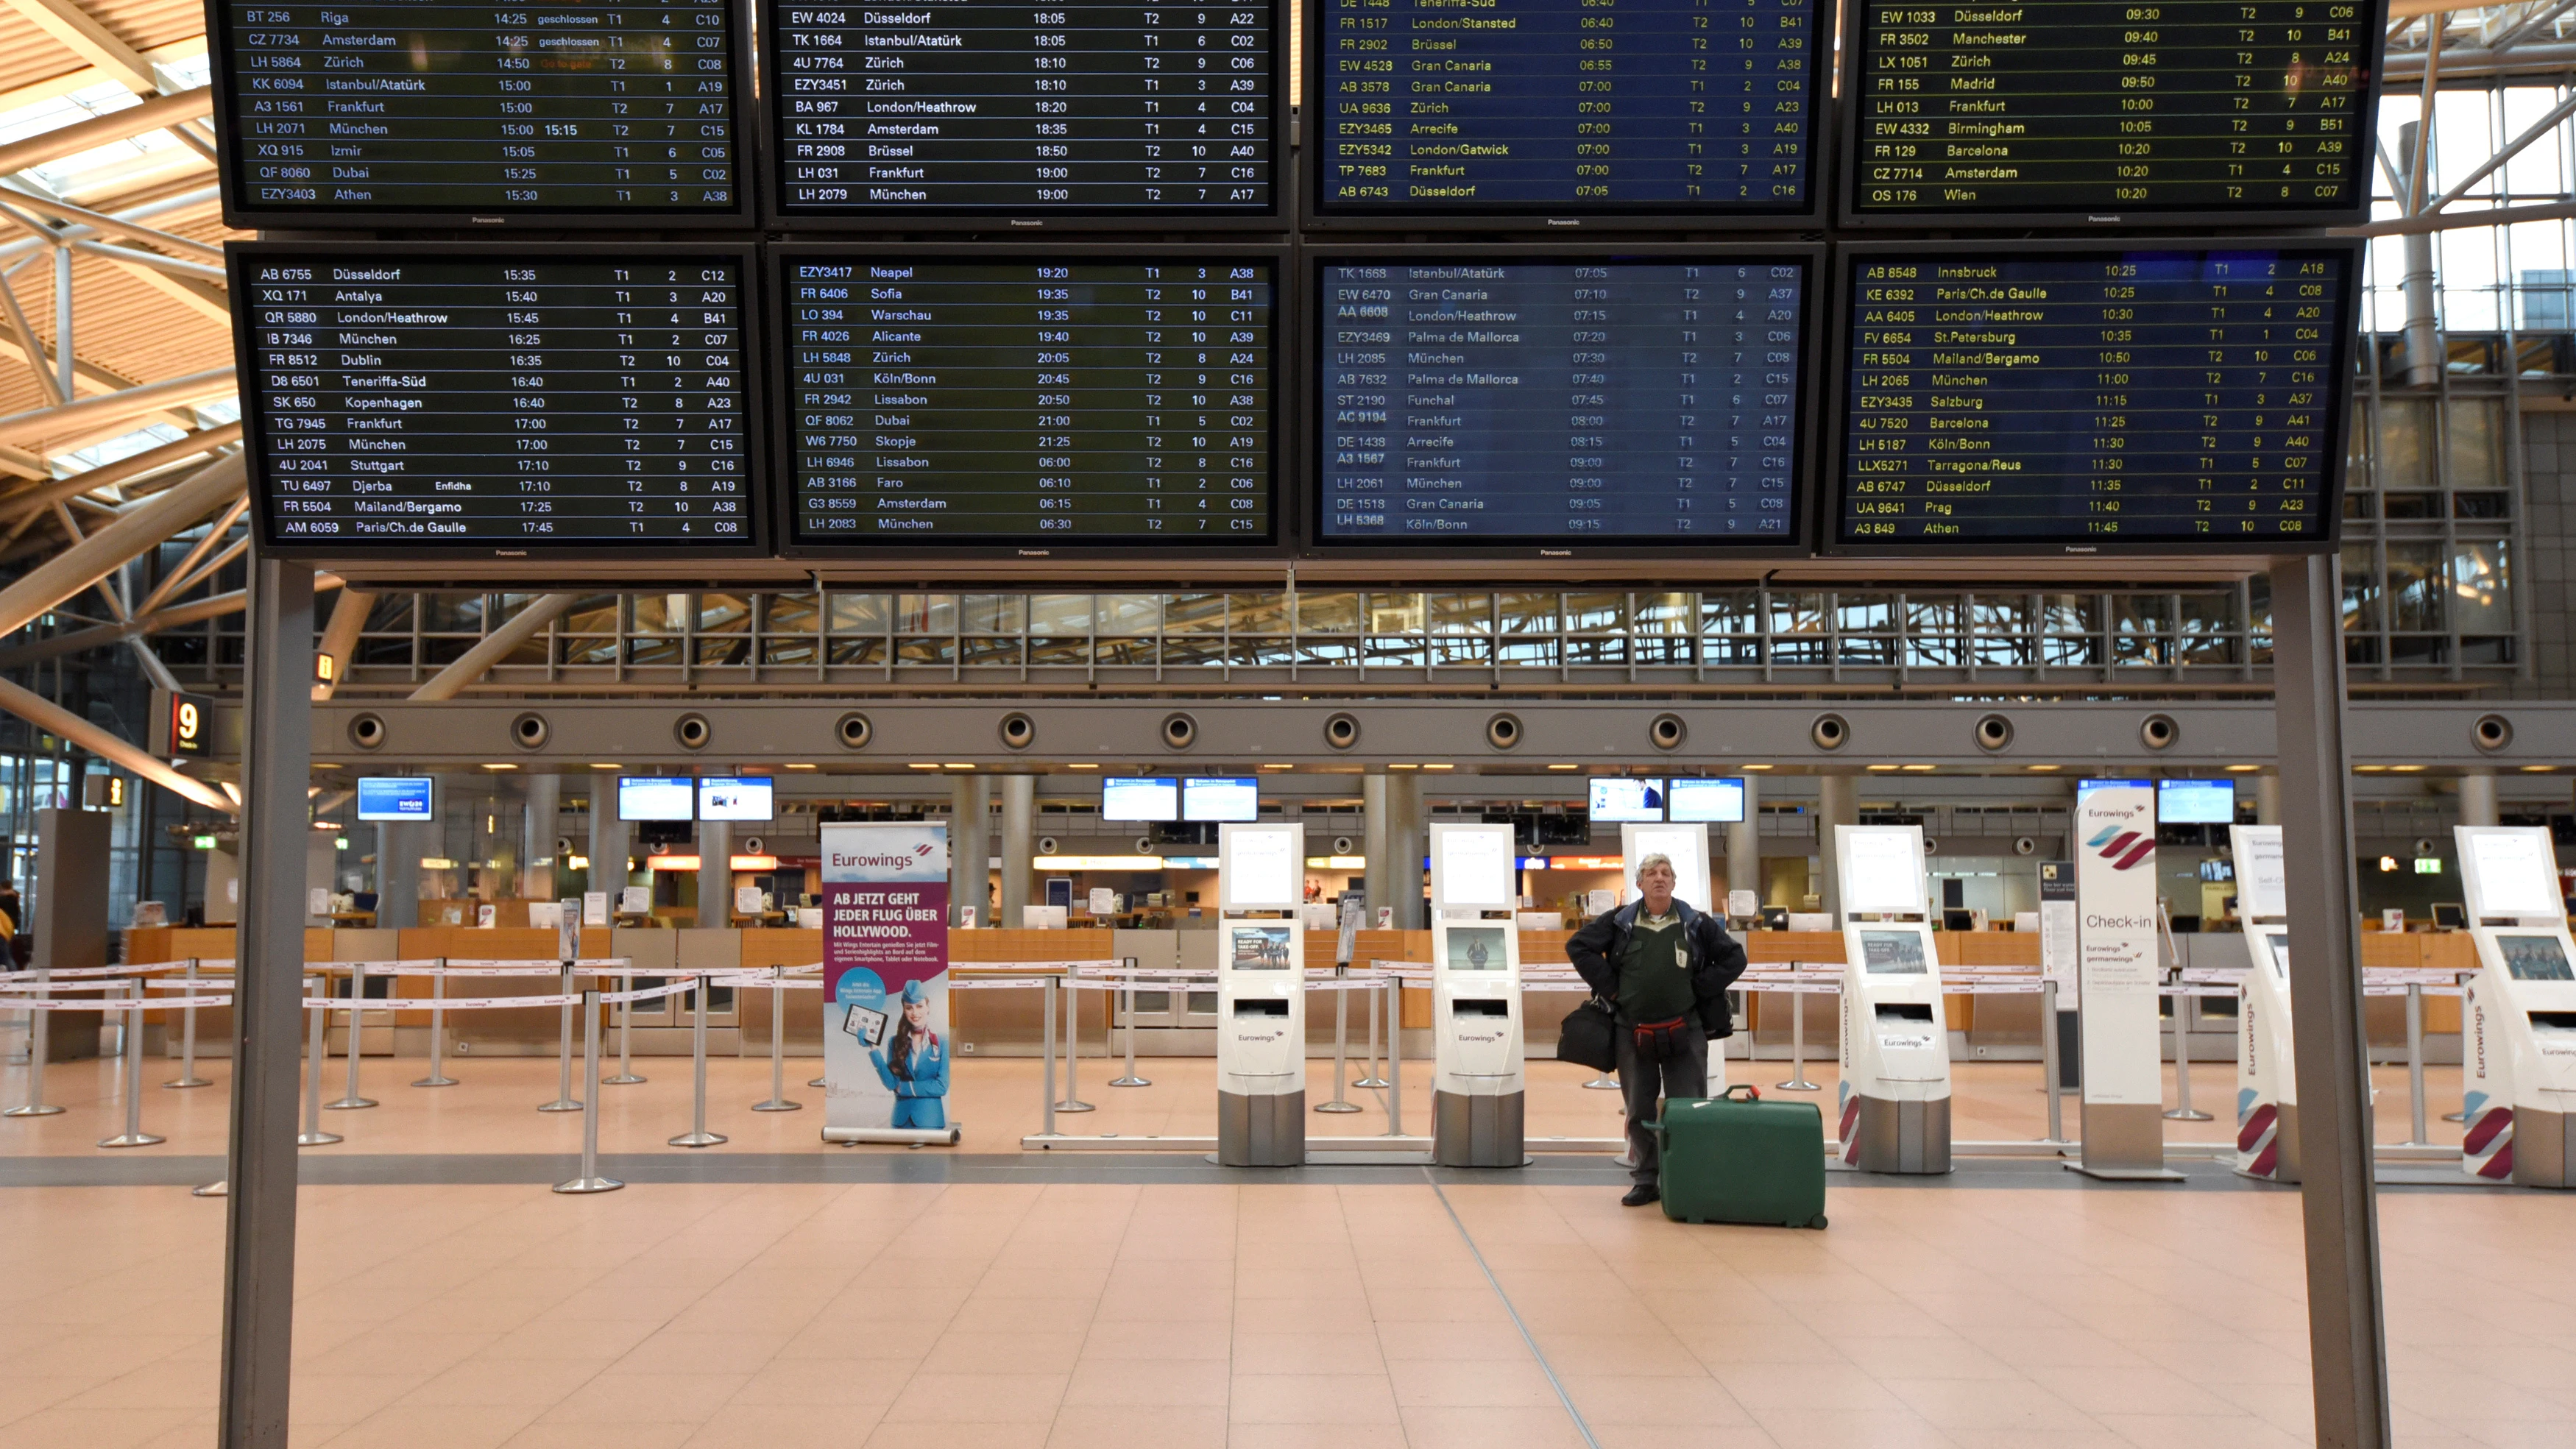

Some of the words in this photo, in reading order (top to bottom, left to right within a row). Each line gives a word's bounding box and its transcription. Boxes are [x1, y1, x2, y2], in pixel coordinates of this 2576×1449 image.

[793, 35, 809, 45] TK
[814, 35, 842, 45] 1664
[866, 35, 961, 46] Istanbul/Atatürk
[1035, 35, 1065, 46] 18:05
[1144, 35, 1158, 46] T1
[1198, 36, 1205, 46] 6
[1231, 35, 1253, 46] C02
[1881, 34, 1895, 45] FR
[1900, 34, 1928, 45] 3502
[1954, 32, 2026, 44] Manchester
[2125, 32, 2158, 42] 09:40
[2239, 30, 2254, 41] T2
[2287, 29, 2301, 40] 10
[2328, 29, 2349, 40] B41
[1340, 60, 1360, 71] EW
[1364, 61, 1393, 71] 4528
[1412, 60, 1440, 71] Gran
[1446, 60, 1490, 71] Canaria
[1580, 60, 1611, 70] 06:55
[1691, 60, 1705, 70] T2
[1746, 60, 1752, 69] 9
[1777, 60, 1800, 69] A38
[255, 101, 271, 111] A3
[276, 102, 302, 112] 1561
[328, 101, 384, 112] Frankfurt
[500, 103, 532, 113] 15:00
[612, 103, 627, 113] T2
[667, 104, 673, 113] 7
[699, 104, 722, 113] A17
[796, 101, 813, 112] BA
[817, 102, 838, 112] 967
[868, 102, 976, 112] London/Heathrow
[1036, 102, 1066, 112] 18:20
[1145, 102, 1158, 112] T1
[1198, 102, 1206, 112] 4
[1231, 102, 1254, 113] C04
[257, 123, 272, 133] LH
[277, 123, 304, 133] 2071
[330, 124, 387, 134] München
[502, 124, 533, 135] 15:00
[545, 125, 577, 135] 15:15
[613, 125, 628, 135] T2
[668, 126, 674, 135] 7
[701, 125, 724, 135] C15
[1876, 124, 1897, 134] EW
[1900, 124, 1929, 134] 4332
[1949, 122, 2024, 136] Birmingham
[2120, 121, 2151, 132] 10:05
[2232, 120, 2247, 131] T2
[2287, 120, 2294, 130] 9
[2321, 118, 2342, 130] B51
[266, 312, 283, 322] QR
[288, 313, 316, 322] 5880
[338, 312, 447, 323] London/Heathrow
[508, 313, 538, 323] 15:45
[618, 313, 631, 323] T1
[671, 313, 679, 323] 4
[704, 313, 725, 323] B41
[1865, 311, 1883, 322] AA
[1887, 311, 1914, 322] 6405
[1936, 310, 2043, 321] London/Heathrow
[2103, 309, 2133, 319] 10:30
[2212, 308, 2224, 318] T1
[2265, 308, 2271, 317] 4
[2296, 307, 2319, 317] A20
[803, 330, 817, 341] FR
[821, 331, 849, 341] 4026
[873, 331, 921, 341] Alicante
[1038, 332, 1069, 341] 19:40
[1146, 332, 1160, 341] T2
[1192, 332, 1206, 341] 10
[1230, 332, 1253, 341] A39
[1338, 353, 1354, 363] LH
[1358, 353, 1385, 363] 2085
[1409, 353, 1463, 363] München
[1574, 353, 1605, 363] 07:30
[1682, 352, 1696, 363] T2
[1735, 352, 1741, 362] 7
[1767, 352, 1789, 362] C08
[274, 397, 291, 407] SK
[294, 397, 315, 407] 650
[346, 397, 422, 410] Kopenhagen
[514, 398, 544, 408] 16:40
[622, 397, 637, 408] T2
[676, 398, 683, 408] 8
[707, 398, 731, 408] A23
[806, 436, 826, 445] W6
[829, 436, 857, 446] 7750
[876, 436, 916, 448] Skopje
[1039, 436, 1069, 446] 21:25
[1147, 437, 1161, 447] T2
[1193, 437, 1206, 447] 10
[1230, 437, 1253, 447] A19
[1857, 503, 1875, 513] UA
[1878, 503, 1904, 513] 9641
[1926, 502, 1951, 515] Prag
[2090, 501, 2119, 511] 11:40
[2197, 500, 2210, 511] T2
[2249, 500, 2256, 510] 9
[2280, 500, 2303, 510] A23
[179, 704, 197, 738] 9
[2089, 809, 2134, 819] Eurowings
[832, 853, 912, 870] Eurowings
[834, 893, 850, 904] AB
[853, 893, 885, 904] JETZT
[888, 893, 919, 904] GEHT
[834, 910, 869, 921] JEDER
[873, 910, 902, 921] FLUG
[906, 907, 937, 921] ÜBER
[2087, 915, 2151, 927] Check-in
[834, 926, 911, 937] HOLLYWOOD.
[2087, 954, 2134, 963] germanwings
[1459, 1035, 1495, 1043] Eurowings
[1884, 1037, 1923, 1048] Eurowings
[2247, 1004, 2255, 1076] Eurowings
[2475, 1006, 2485, 1079] Eurowings
